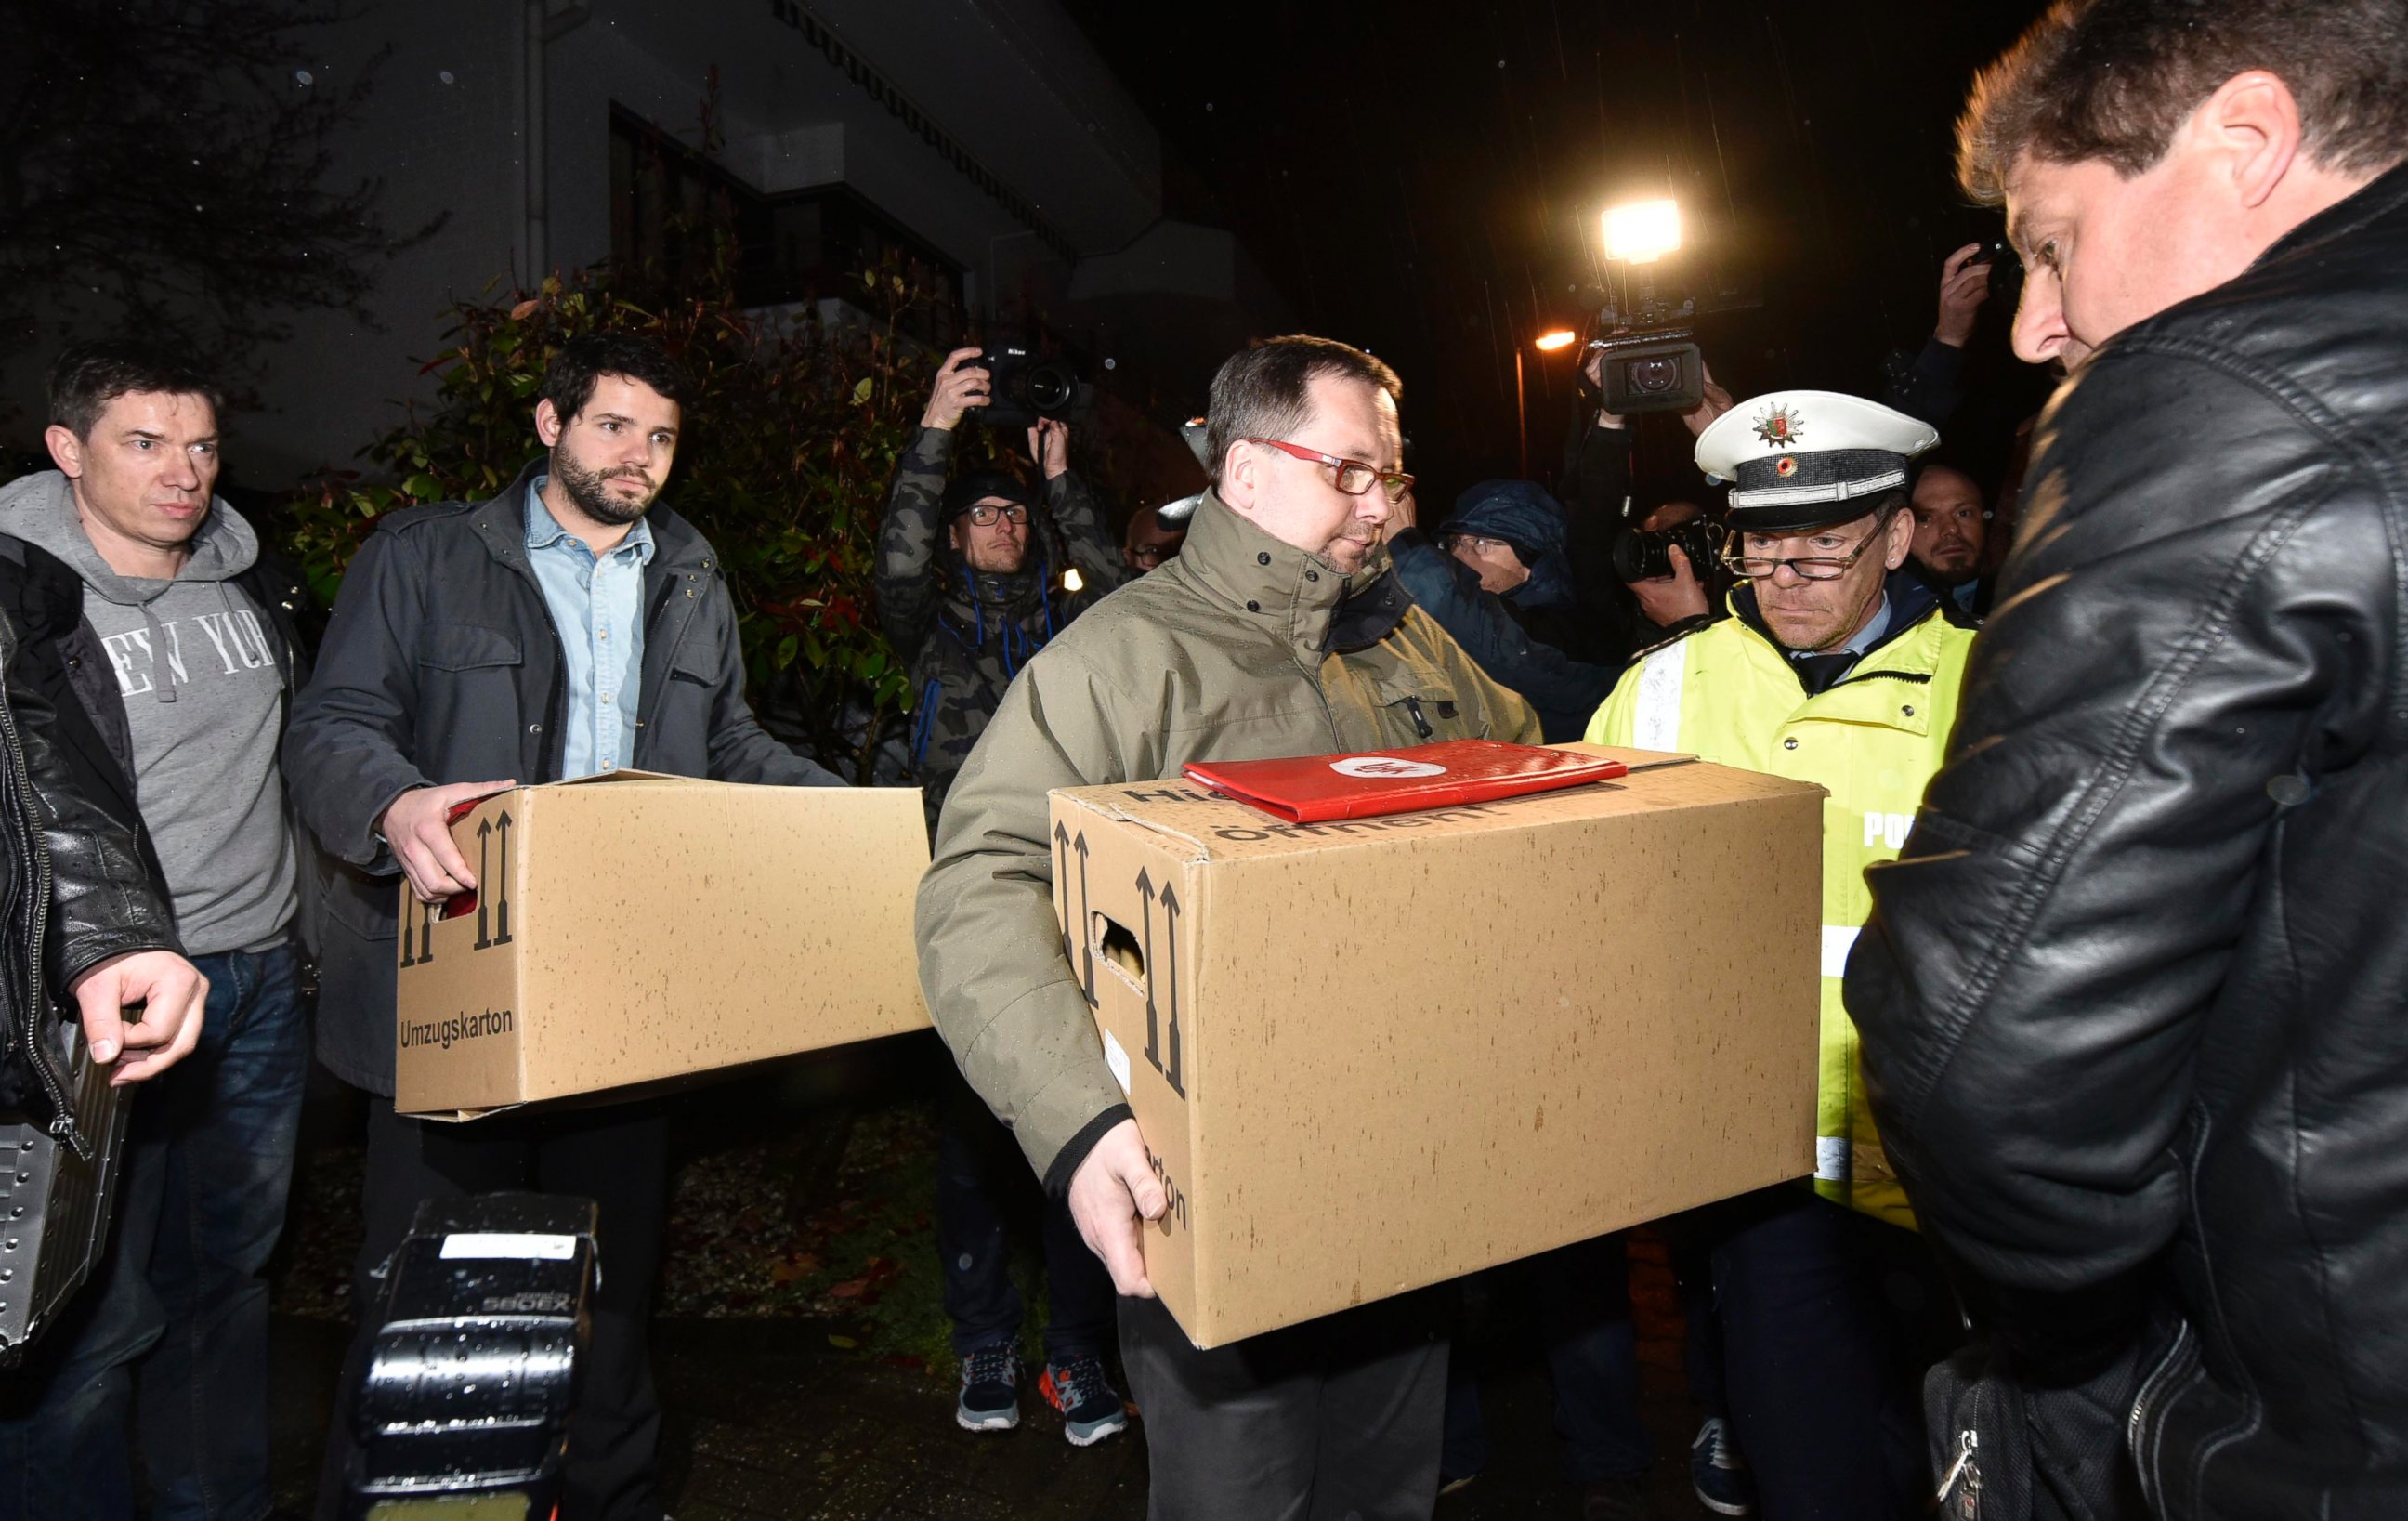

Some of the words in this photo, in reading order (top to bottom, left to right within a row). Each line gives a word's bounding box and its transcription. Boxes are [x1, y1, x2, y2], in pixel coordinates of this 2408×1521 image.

[100, 621, 189, 697] EW
[191, 610, 275, 675] YOR
[1122, 788, 1234, 803] Hie
[400, 1007, 513, 1049] Umzugskarton
